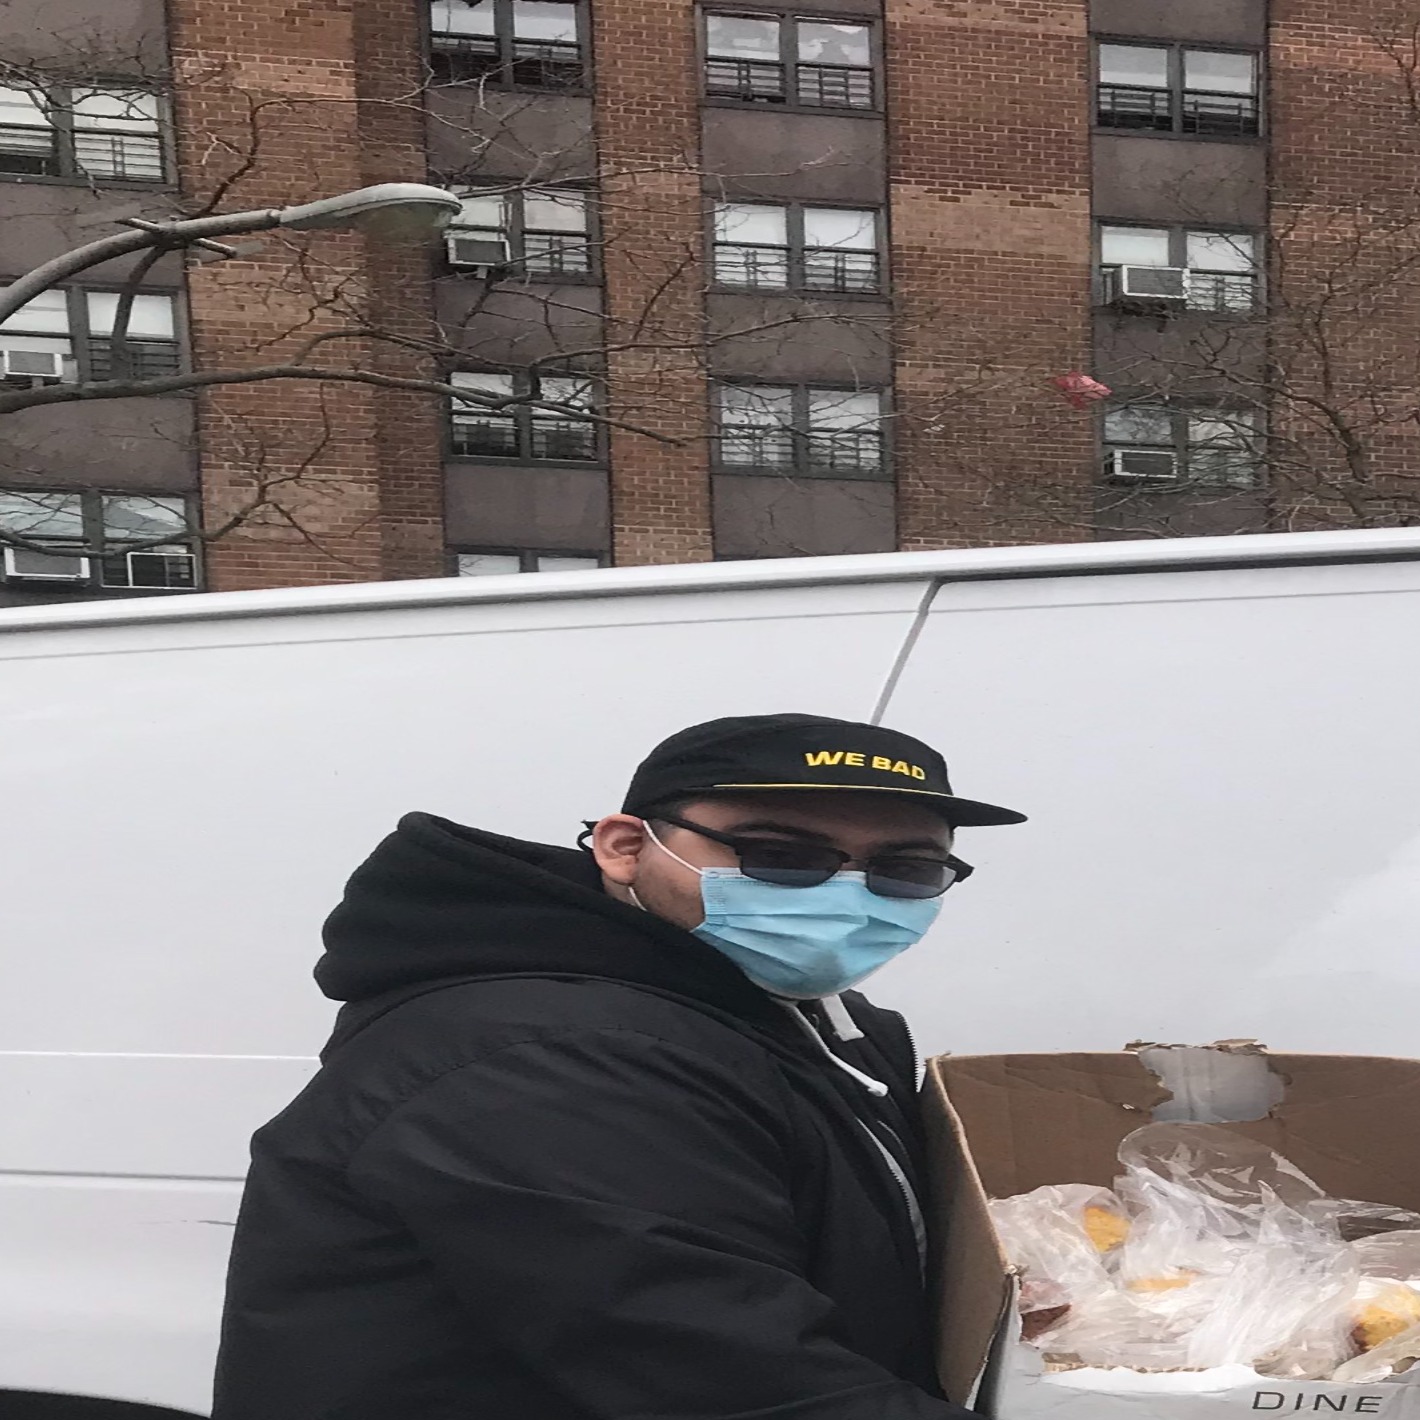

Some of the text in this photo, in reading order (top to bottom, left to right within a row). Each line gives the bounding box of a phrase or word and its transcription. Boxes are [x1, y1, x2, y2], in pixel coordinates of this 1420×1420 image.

[804, 751, 926, 781] WE BAD
[1252, 1391, 1384, 1413] DINE
